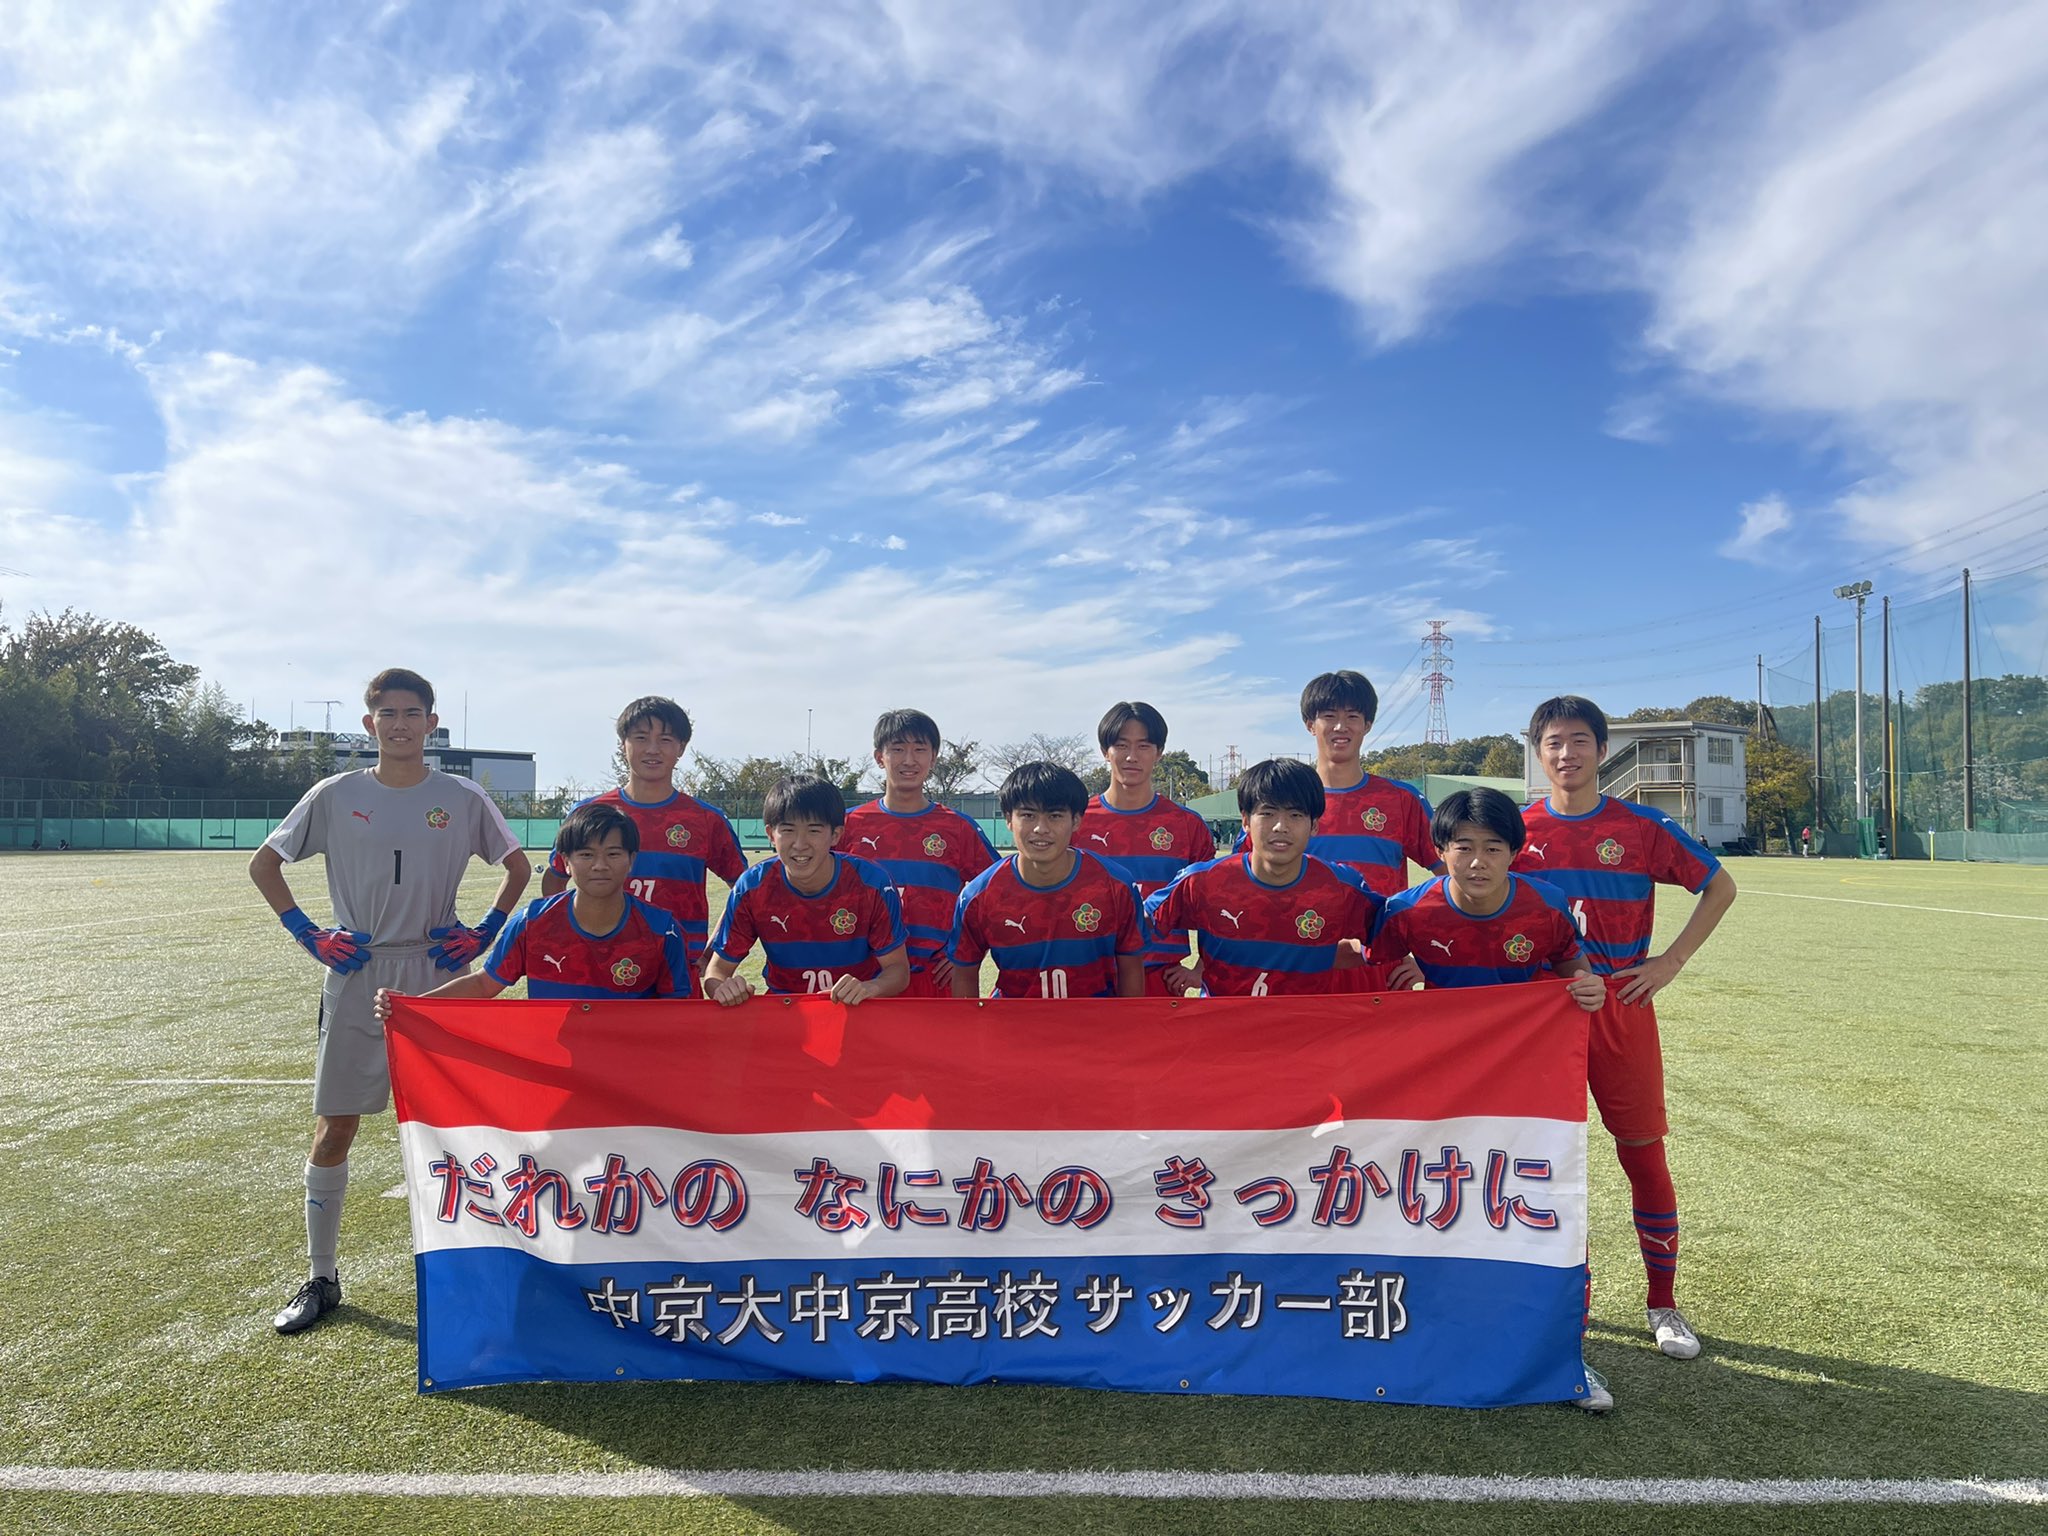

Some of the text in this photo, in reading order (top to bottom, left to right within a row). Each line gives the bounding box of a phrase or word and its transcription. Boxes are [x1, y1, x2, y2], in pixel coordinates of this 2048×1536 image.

[394, 850, 402, 884] 1
[1039, 969, 1068, 999] 10
[1251, 972, 1268, 997] 6
[428, 1145, 1559, 1239] だれかの なにかの きっかけに
[585, 1269, 1409, 1346] 中京大中京高校サッカー部
